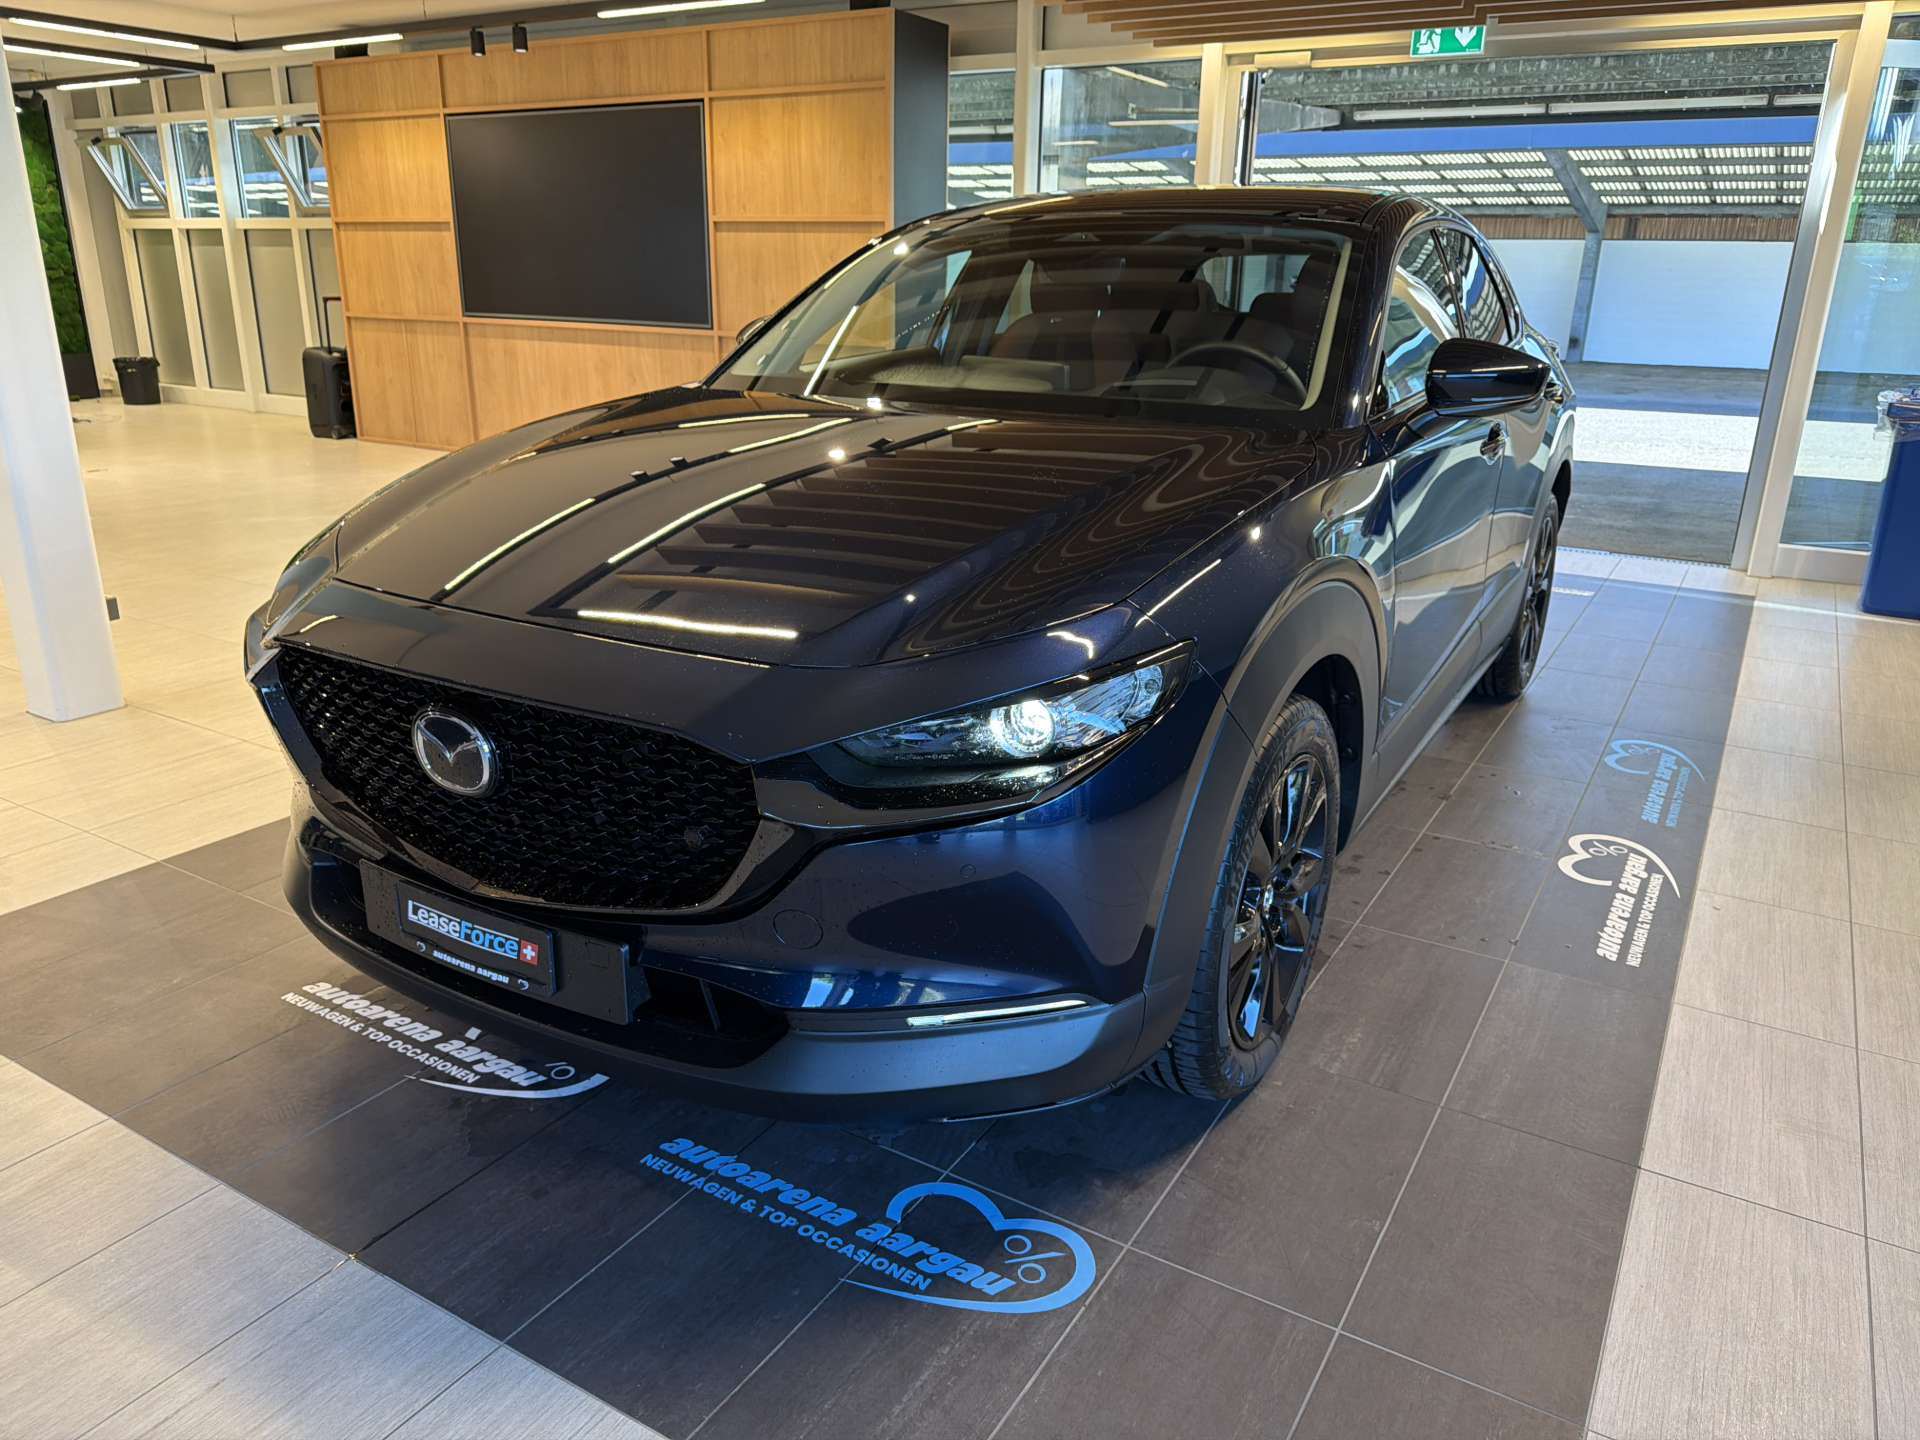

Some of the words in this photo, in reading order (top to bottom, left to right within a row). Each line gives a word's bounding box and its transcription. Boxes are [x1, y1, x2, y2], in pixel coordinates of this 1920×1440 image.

[408, 899, 519, 957] LeaseForce
[1596, 892, 1636, 961] autoarena
[1618, 852, 1648, 895] aargau
[280, 991, 356, 1028] NEUWAGEN
[350, 1021, 365, 1033] &
[361, 1026, 392, 1043] TOP
[388, 1038, 481, 1084] OCCASIONEN
[302, 982, 443, 1042] autoarena
[434, 1039, 548, 1087] aargau
[639, 1153, 743, 1208] NEUWAGEN
[739, 1198, 756, 1213] &
[758, 1205, 798, 1230] TOP
[796, 1223, 933, 1291] OCCASIONEN
[659, 1136, 858, 1227] autoarena
[855, 1217, 1017, 1296] aargau
